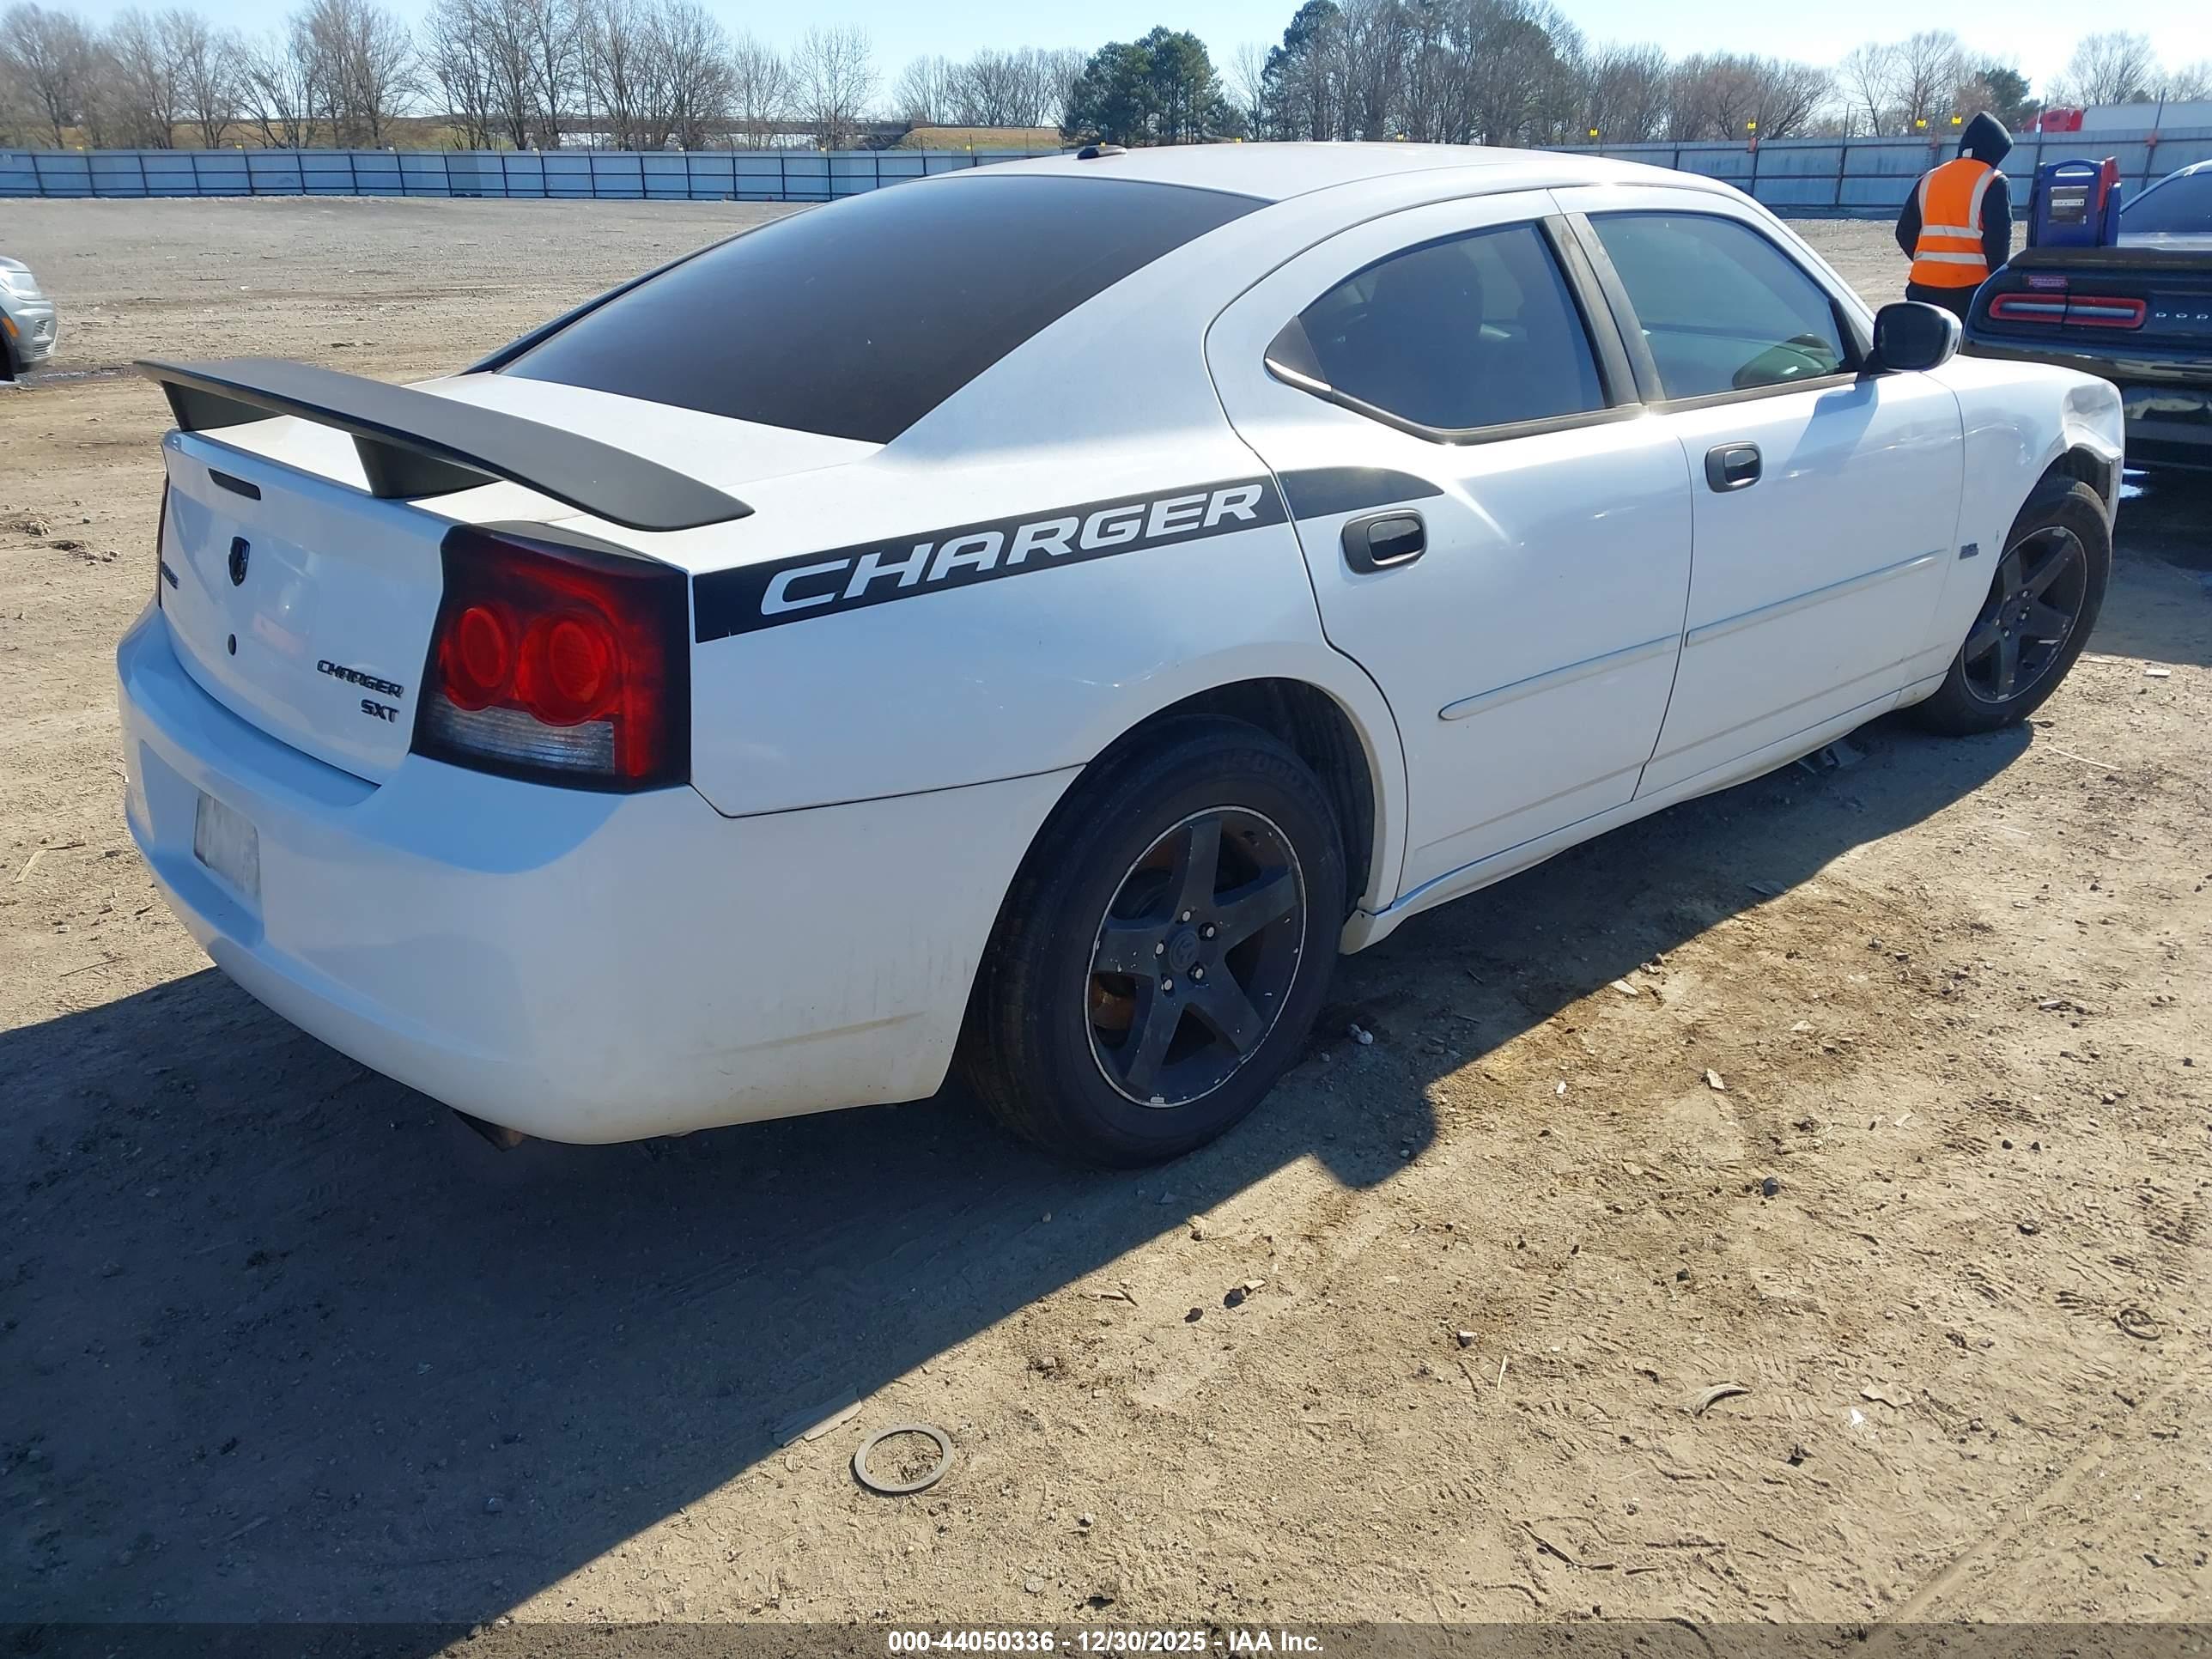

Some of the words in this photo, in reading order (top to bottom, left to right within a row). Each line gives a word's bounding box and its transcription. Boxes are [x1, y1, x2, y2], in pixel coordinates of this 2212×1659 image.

[760, 483, 1264, 616] CHARGER
[317, 659, 404, 698] CHARGER
[361, 699, 400, 723] SXT
